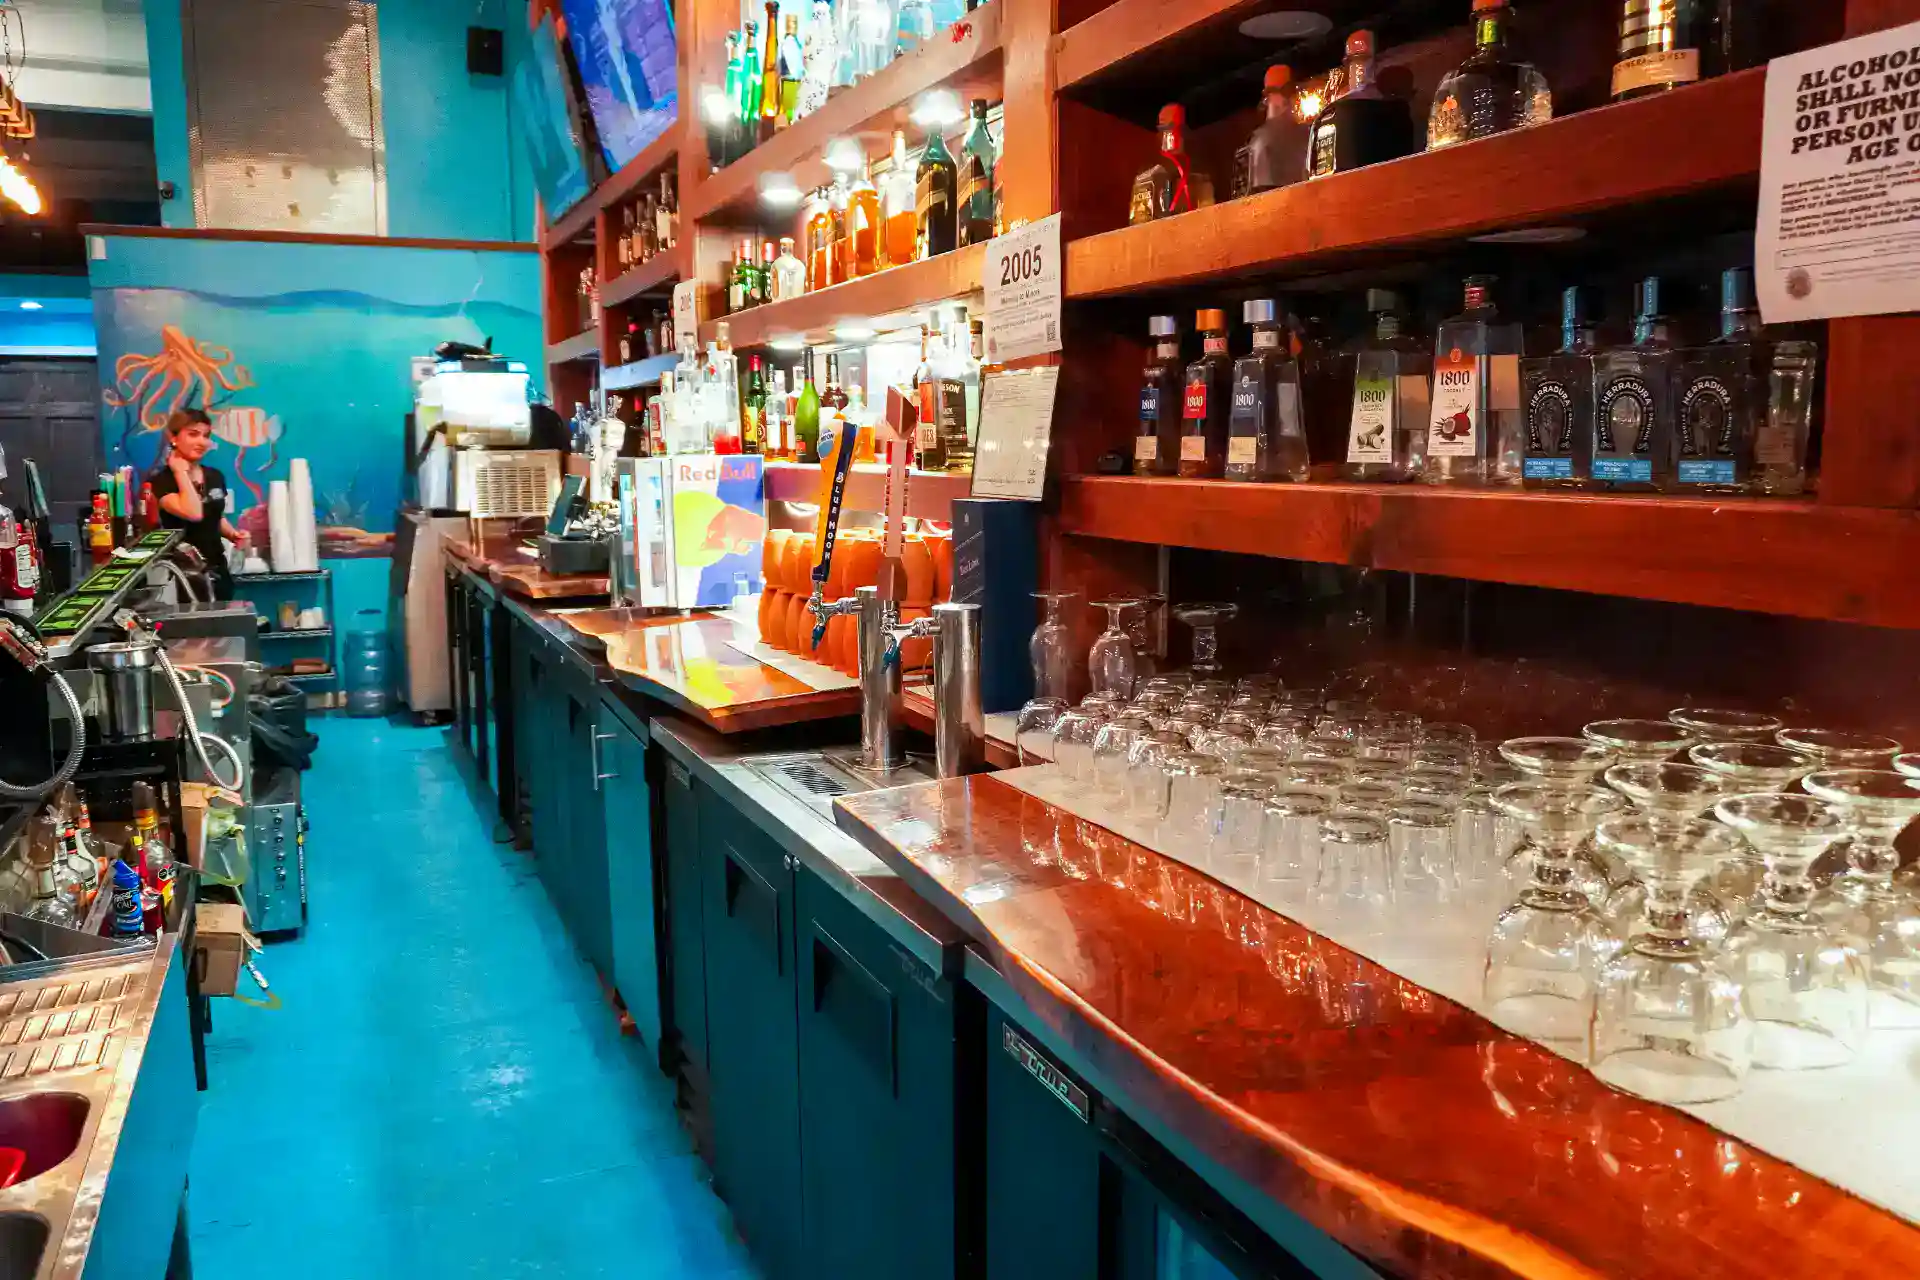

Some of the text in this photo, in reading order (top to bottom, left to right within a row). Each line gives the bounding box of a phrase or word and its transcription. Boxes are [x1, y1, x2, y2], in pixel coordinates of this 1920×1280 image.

[1796, 80, 1876, 113] SHALL
[1796, 110, 1831, 133] OR
[1791, 116, 1897, 154] PERSON
[1845, 138, 1900, 166] AGE
[1001, 244, 1042, 287] 2005
[1440, 370, 1470, 386] 1800
[1142, 399, 1156, 410] 1800
[1187, 396, 1203, 407] 1800
[1235, 393, 1254, 406] 1800
[1360, 390, 1386, 402] 1800
[1530, 385, 1572, 407] HERRADURA
[1601, 381, 1652, 405] HERRADURA
[1682, 381, 1731, 405] HERRADURA
[680, 461, 717, 481] Red
[825, 471, 844, 561] BLUE MOON
